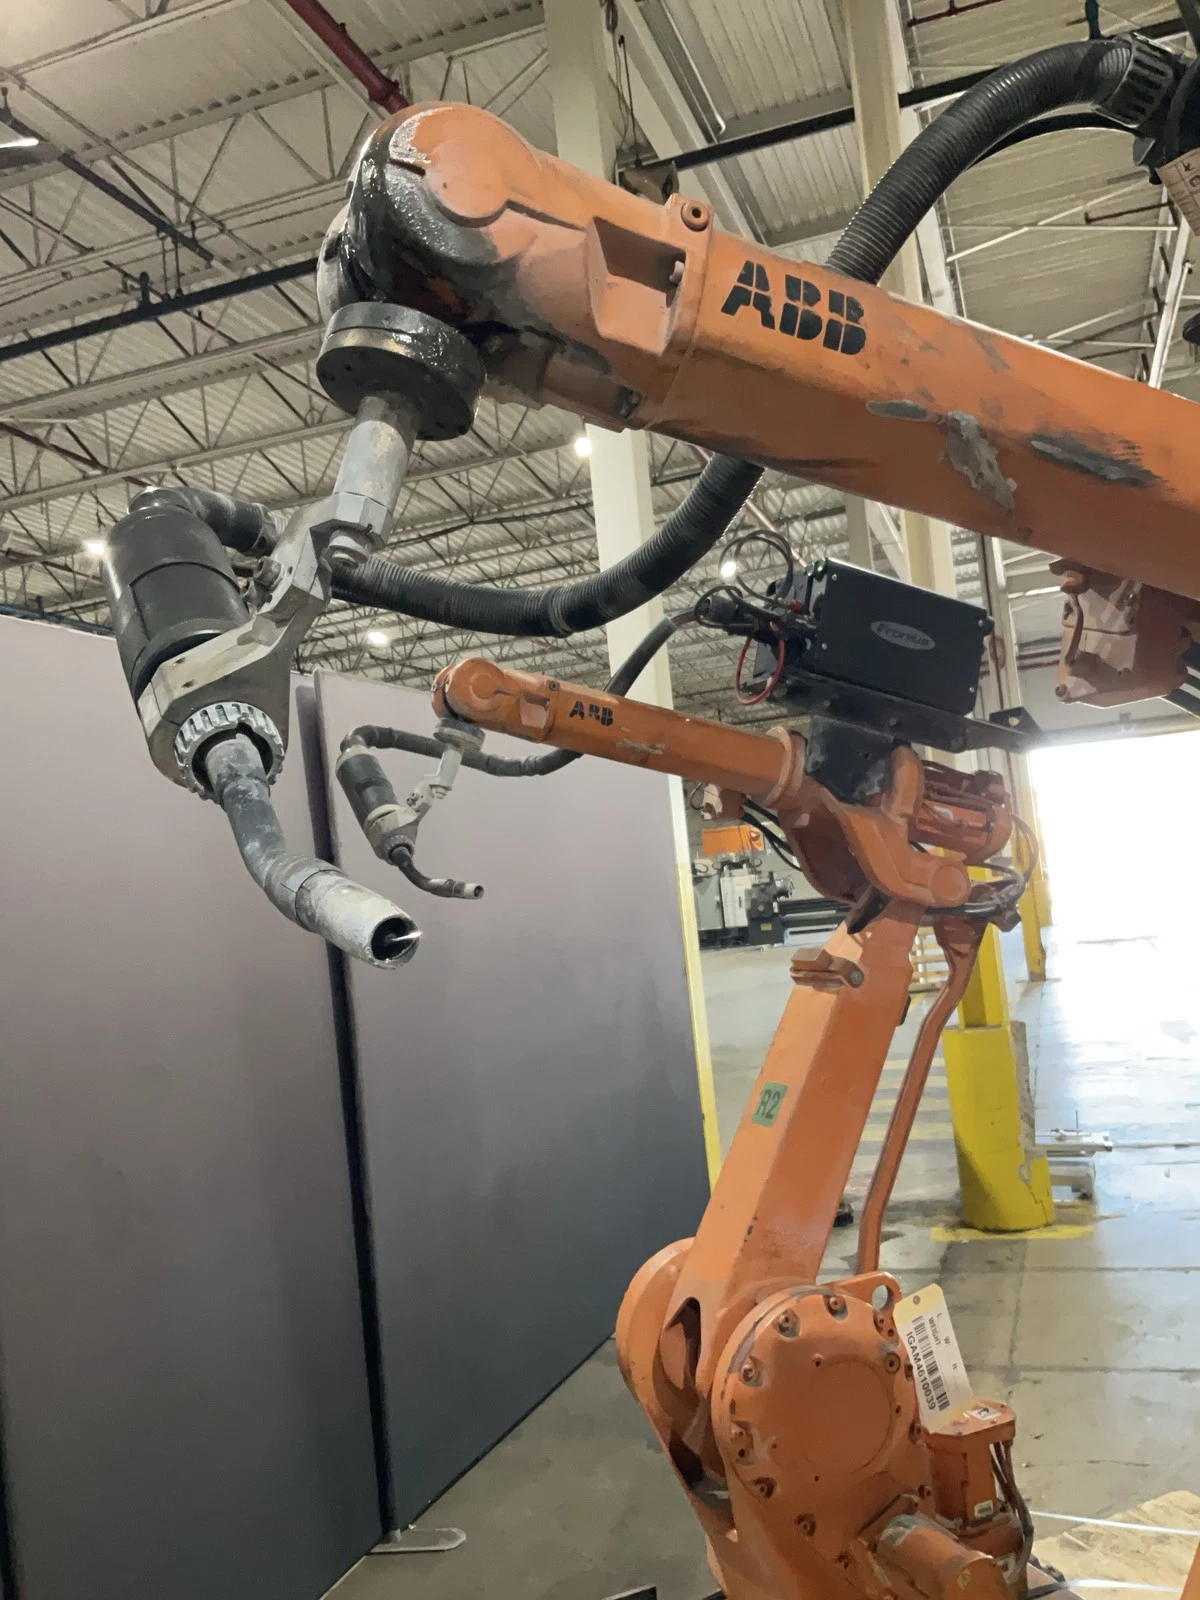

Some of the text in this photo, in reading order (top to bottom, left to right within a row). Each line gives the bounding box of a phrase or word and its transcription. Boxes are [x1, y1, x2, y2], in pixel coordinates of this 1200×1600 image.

[720, 259, 867, 355] ABB
[569, 700, 613, 726] ABB
[905, 1331, 936, 1411] IGAM4610039
